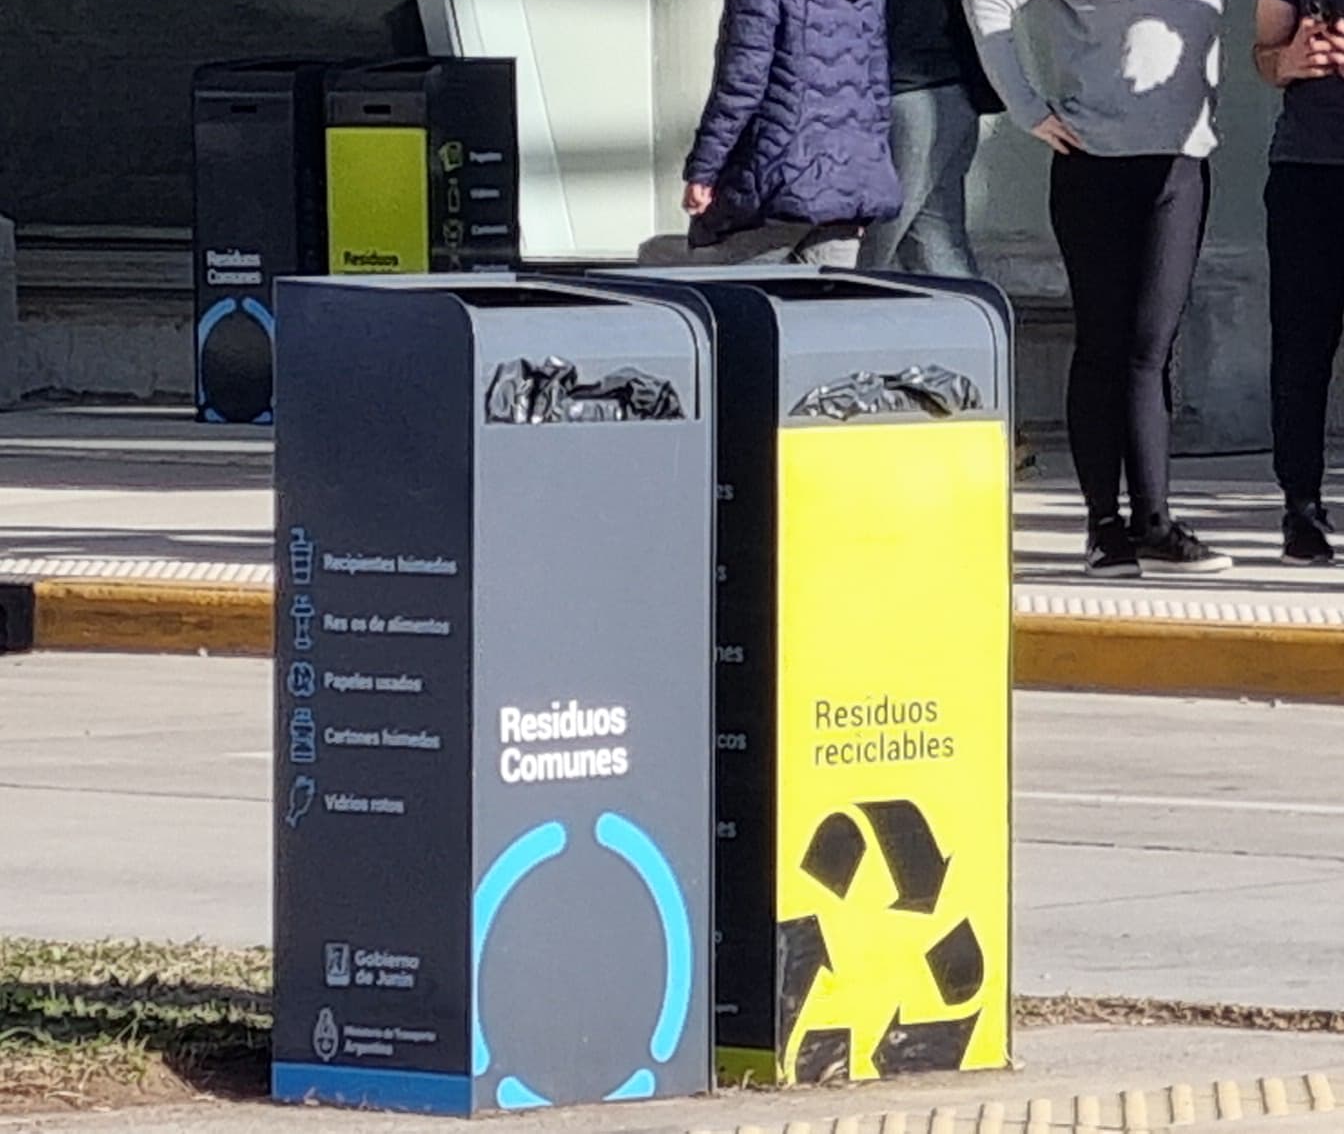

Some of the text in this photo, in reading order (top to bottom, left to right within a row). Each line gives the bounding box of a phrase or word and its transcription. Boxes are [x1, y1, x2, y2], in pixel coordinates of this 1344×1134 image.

[369, 615, 385, 633] de
[323, 672, 373, 693] Papeles
[500, 700, 627, 743] Residuos
[815, 695, 938, 729] Residuos
[814, 730, 955, 766] reciclables
[500, 746, 629, 784] Comunes
[354, 949, 420, 971] Gobierno
[355, 970, 373, 986] de
